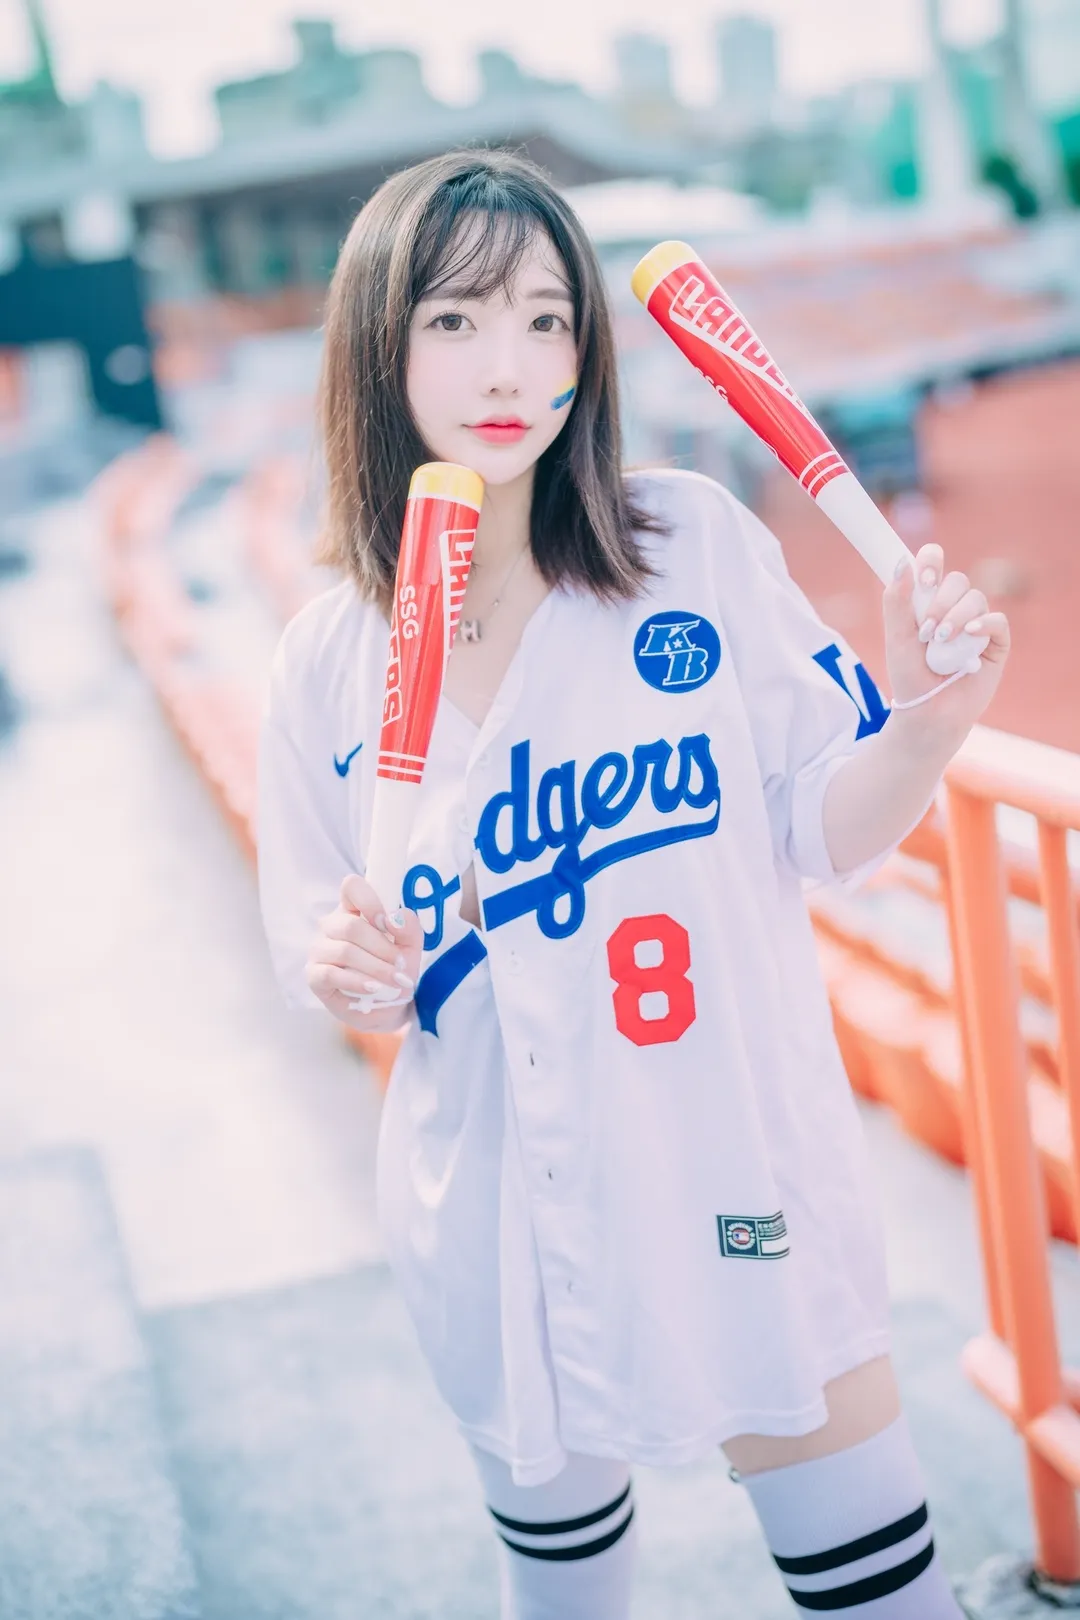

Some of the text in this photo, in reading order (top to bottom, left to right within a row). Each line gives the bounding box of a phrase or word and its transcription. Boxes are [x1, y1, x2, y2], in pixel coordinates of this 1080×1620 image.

[400, 584, 420, 640] SSG
[638, 620, 707, 687] KB
[402, 733, 721, 950] odgers
[606, 913, 697, 1047] 8
